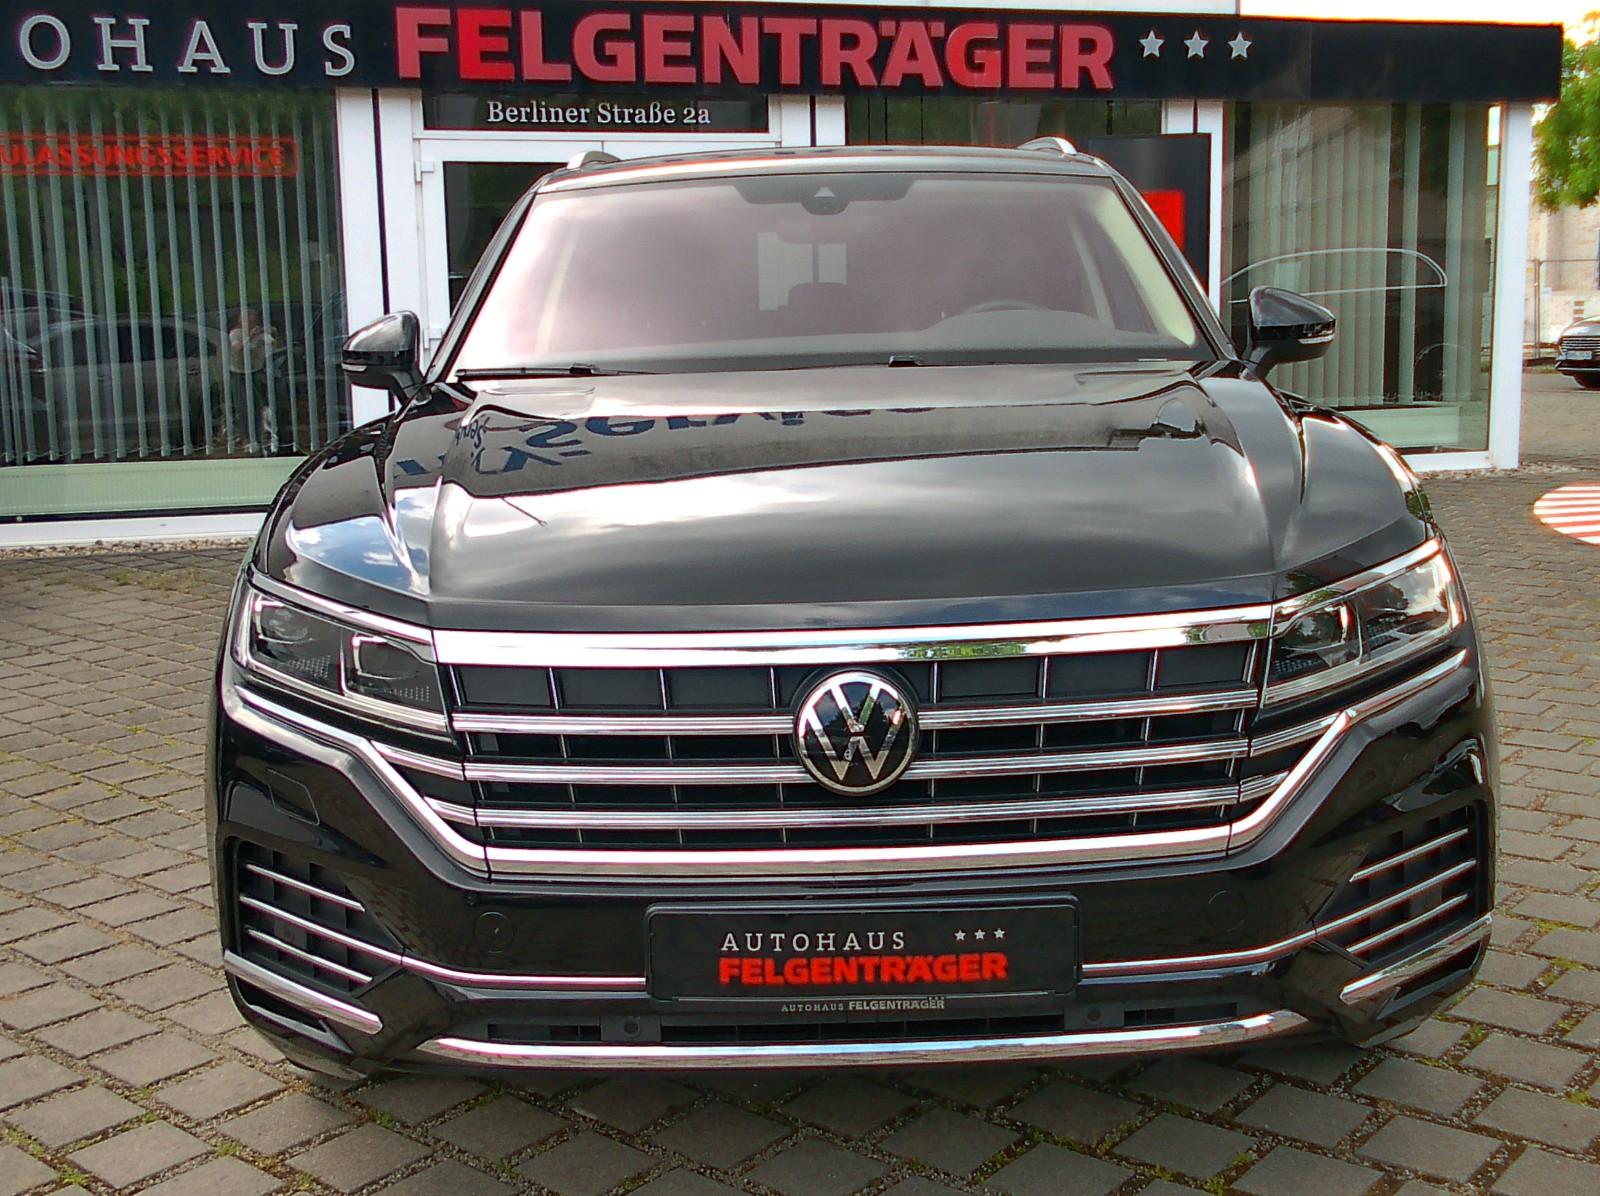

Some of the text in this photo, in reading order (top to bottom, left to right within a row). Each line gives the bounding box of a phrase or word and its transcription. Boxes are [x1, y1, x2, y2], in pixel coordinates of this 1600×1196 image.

[18, 7, 1115, 90] OHAUS FELGENTRÄGER
[486, 99, 711, 126] Berliner Straße 2a
[721, 932, 905, 952] AUTOHAUS
[719, 953, 1008, 984] FELGENTRÄGER
[780, 999, 945, 1013] AUTOHAUS FELGENTRÄGER
